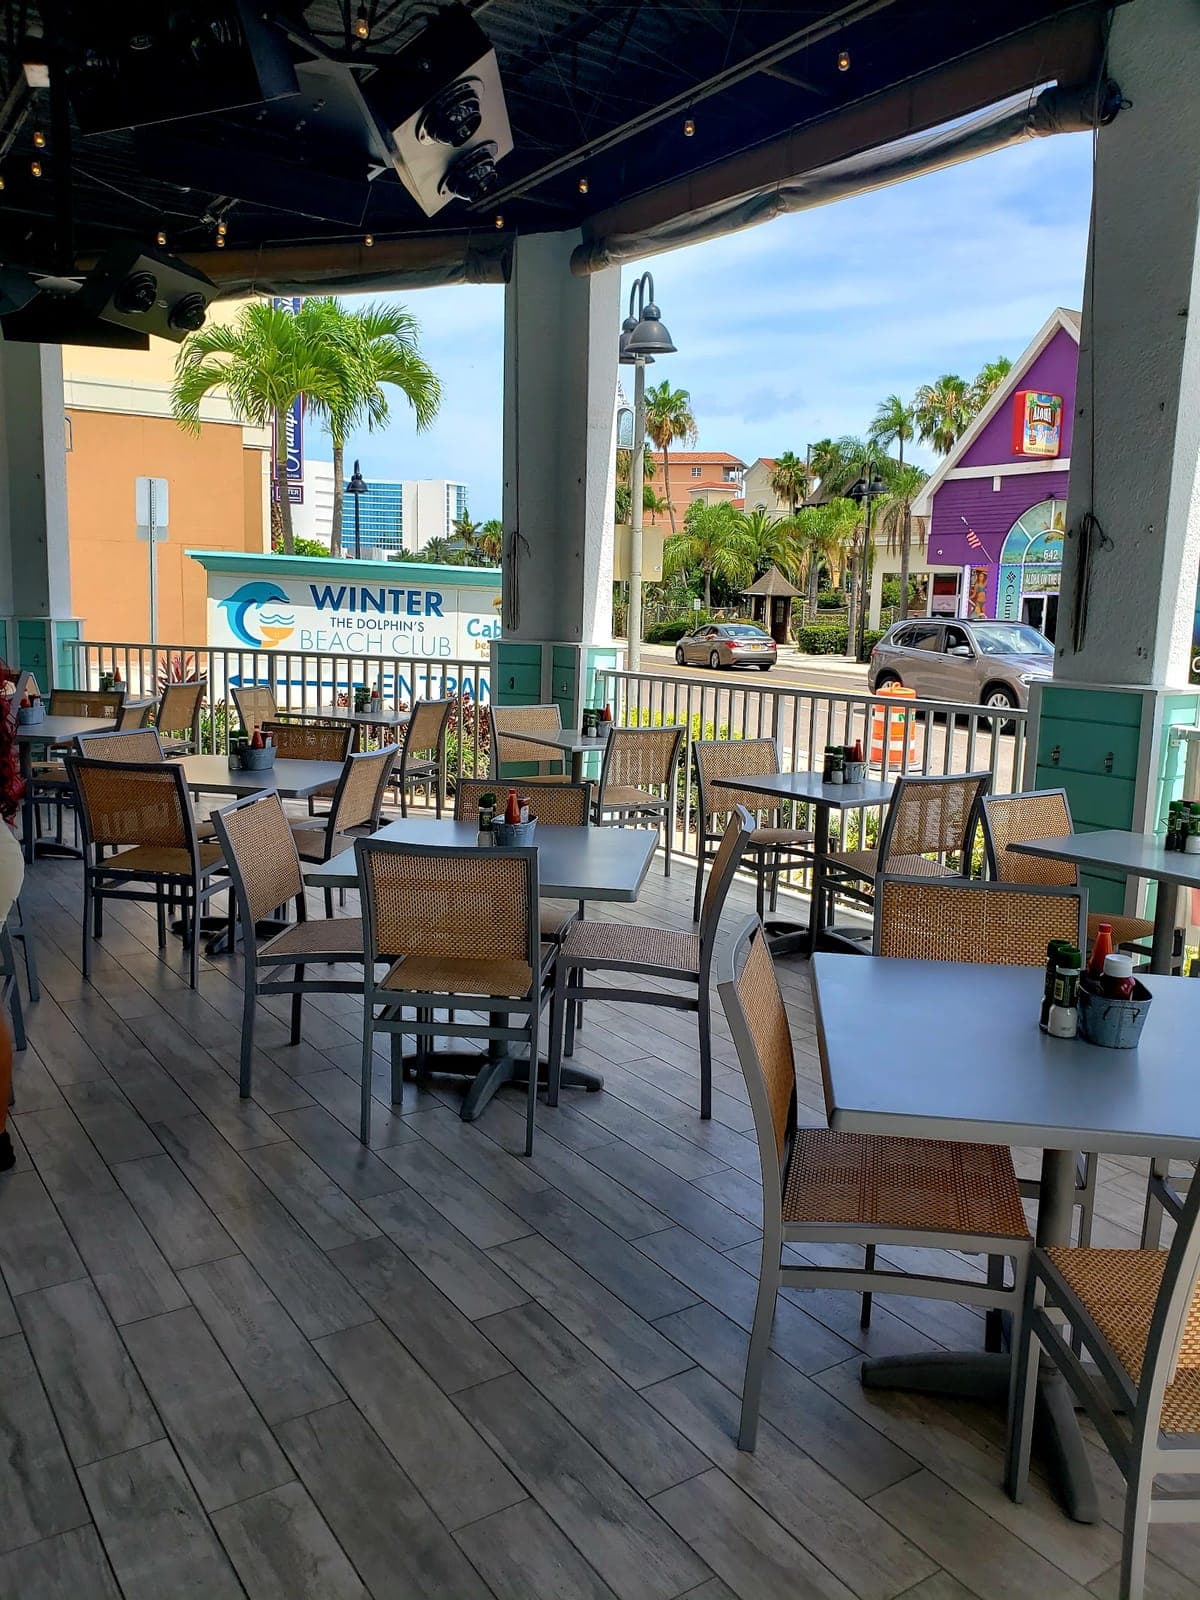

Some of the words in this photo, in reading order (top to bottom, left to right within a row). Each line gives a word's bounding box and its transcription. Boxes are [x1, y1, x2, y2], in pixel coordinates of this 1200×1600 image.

[1033, 405, 1053, 423] ALOHA
[1043, 549, 1058, 560] 642
[309, 584, 445, 617] WINTER
[330, 616, 353, 629] THE
[357, 618, 425, 632] DOLPHIN'S
[466, 618, 502, 638] Cab
[300, 629, 383, 653] BEACH
[391, 634, 452, 657] CLUB
[378, 673, 491, 702] ENTRAN
